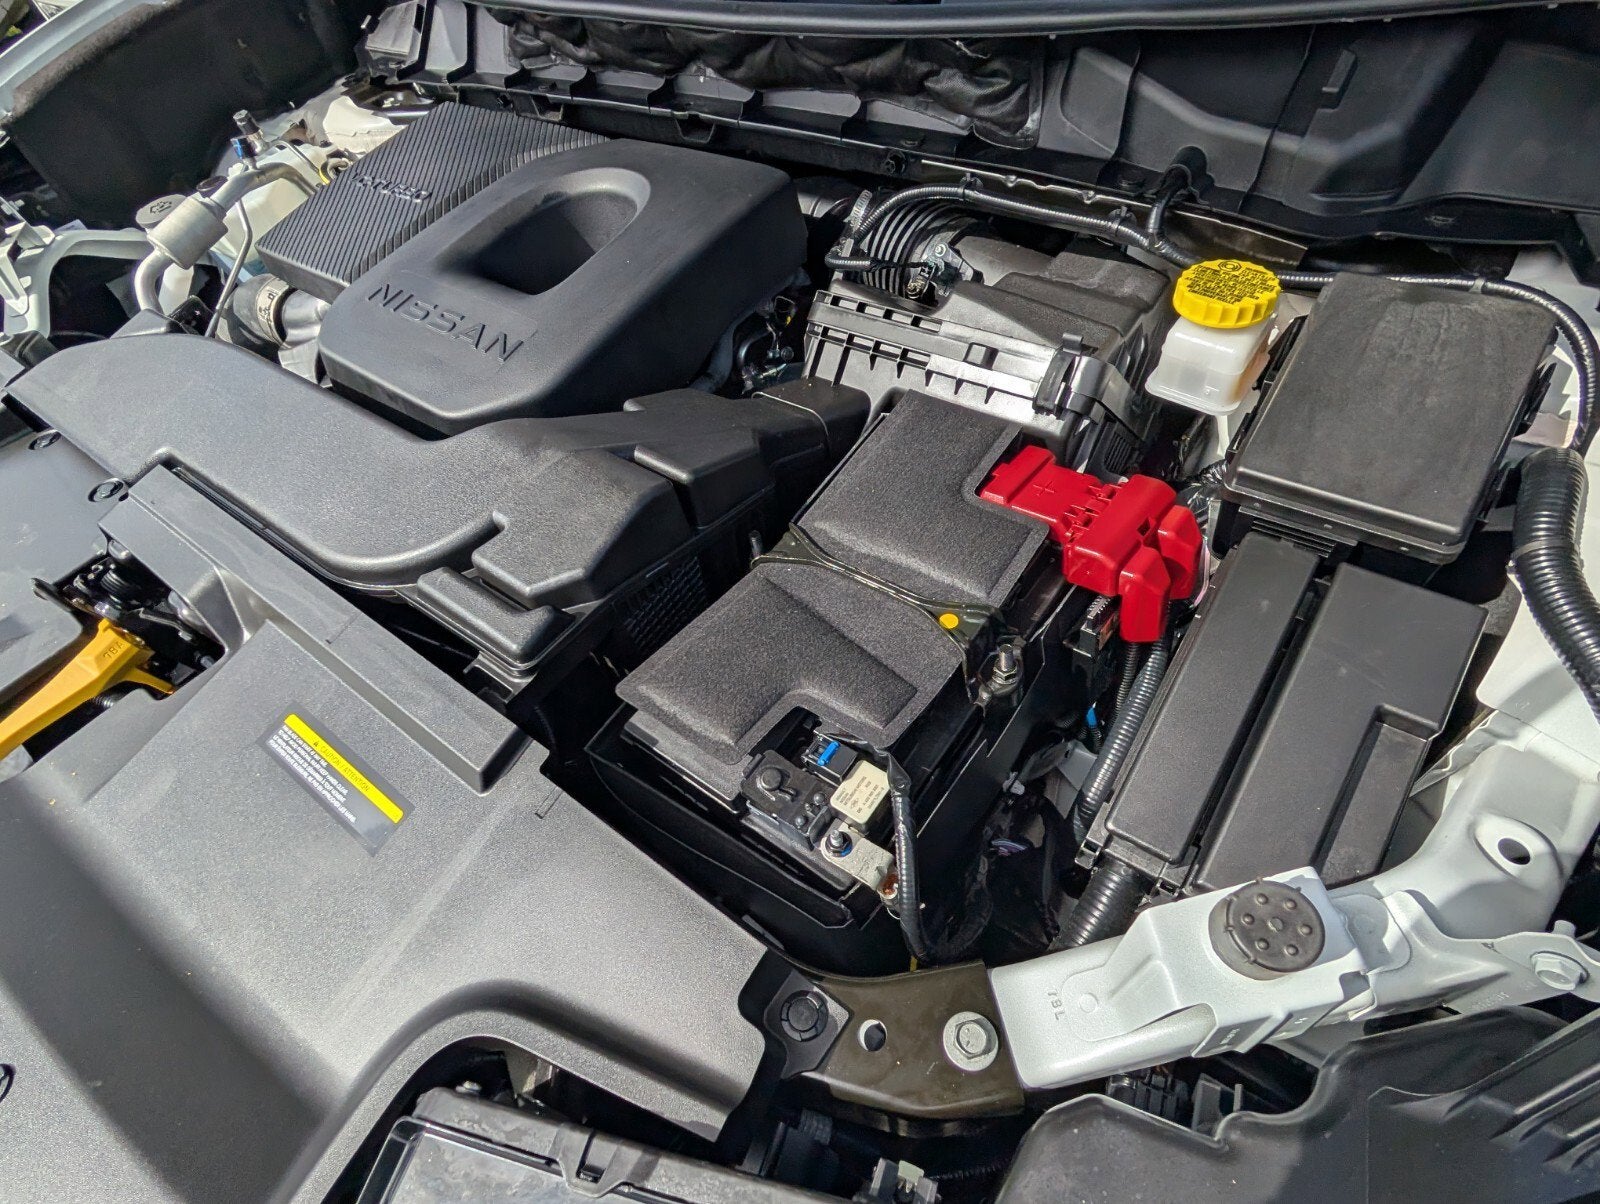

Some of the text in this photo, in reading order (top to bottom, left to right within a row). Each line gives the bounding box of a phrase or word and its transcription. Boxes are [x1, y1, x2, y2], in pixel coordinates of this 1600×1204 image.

[367, 283, 524, 362] NISSAN
[318, 745, 341, 766] CAUTION
[342, 765, 371, 791] ATTENTION
